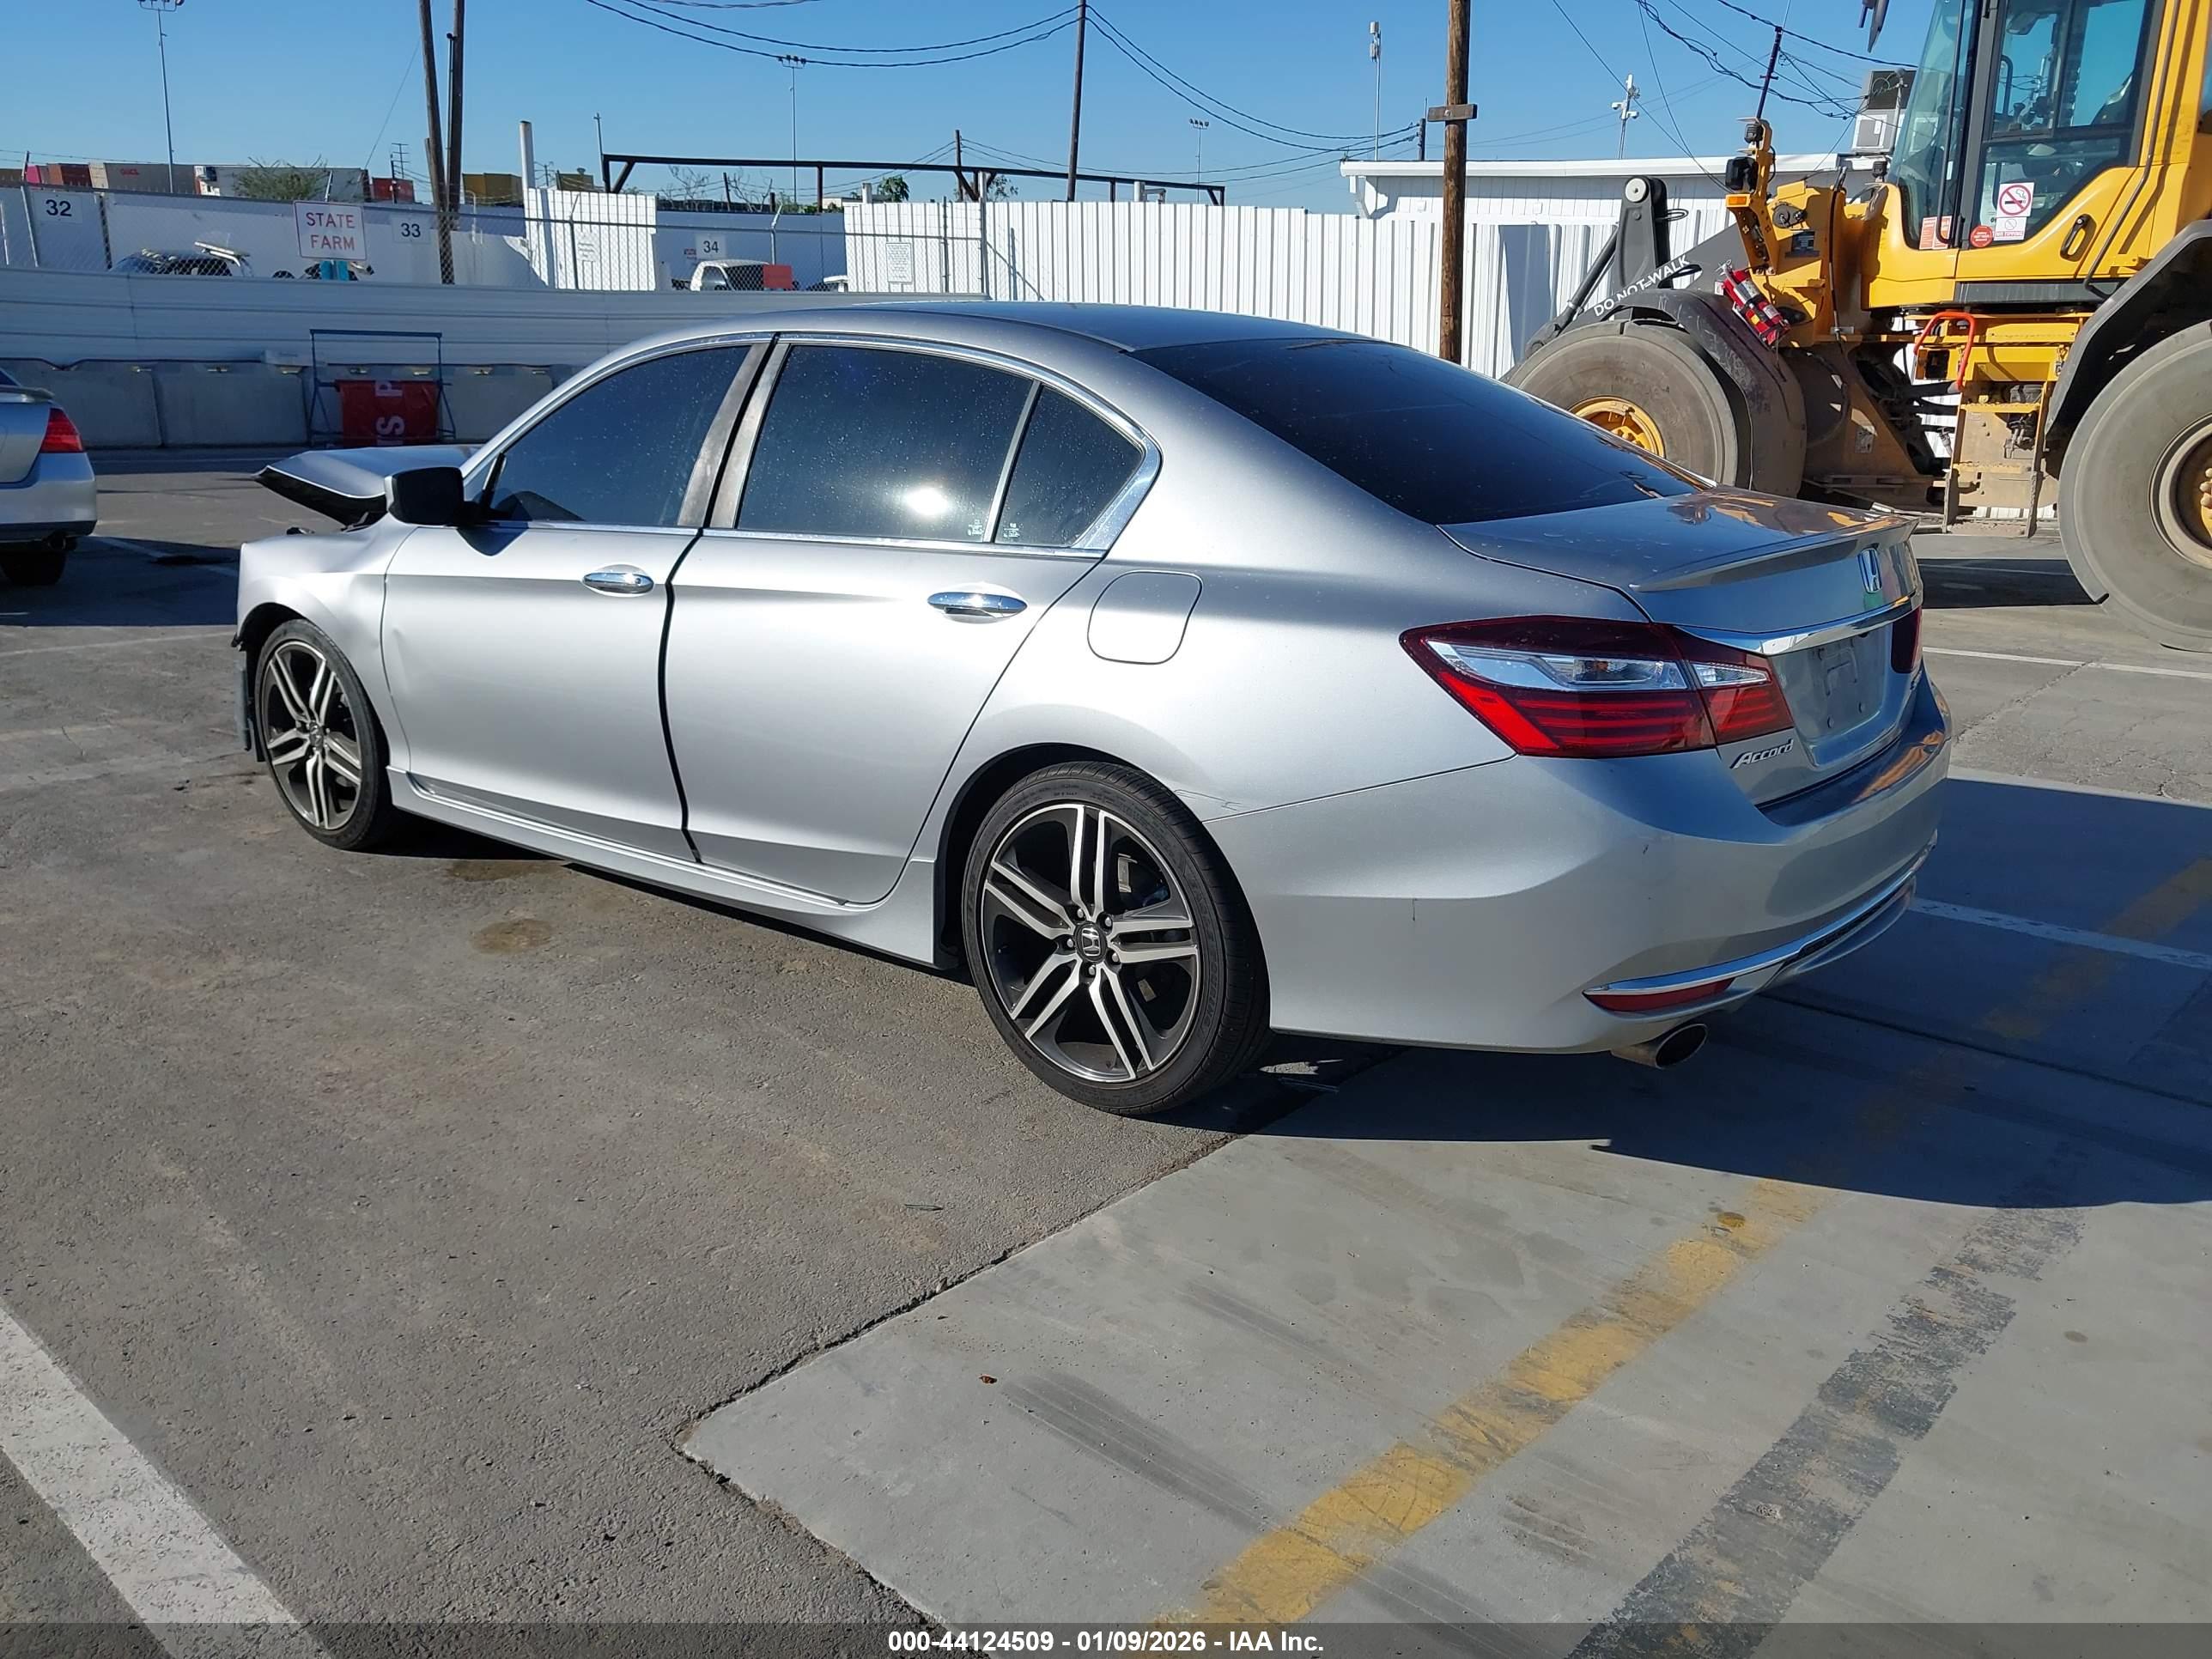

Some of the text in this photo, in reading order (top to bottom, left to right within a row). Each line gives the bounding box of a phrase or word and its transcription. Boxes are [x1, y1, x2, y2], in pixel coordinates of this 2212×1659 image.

[45, 198, 72, 217] 32
[306, 212, 356, 228] STATE
[400, 222, 422, 238] 33
[310, 234, 356, 252] FARM
[703, 240, 720, 253] 34
[1593, 254, 1691, 317] DO NOT WALK
[1729, 738, 1795, 769] Accord
